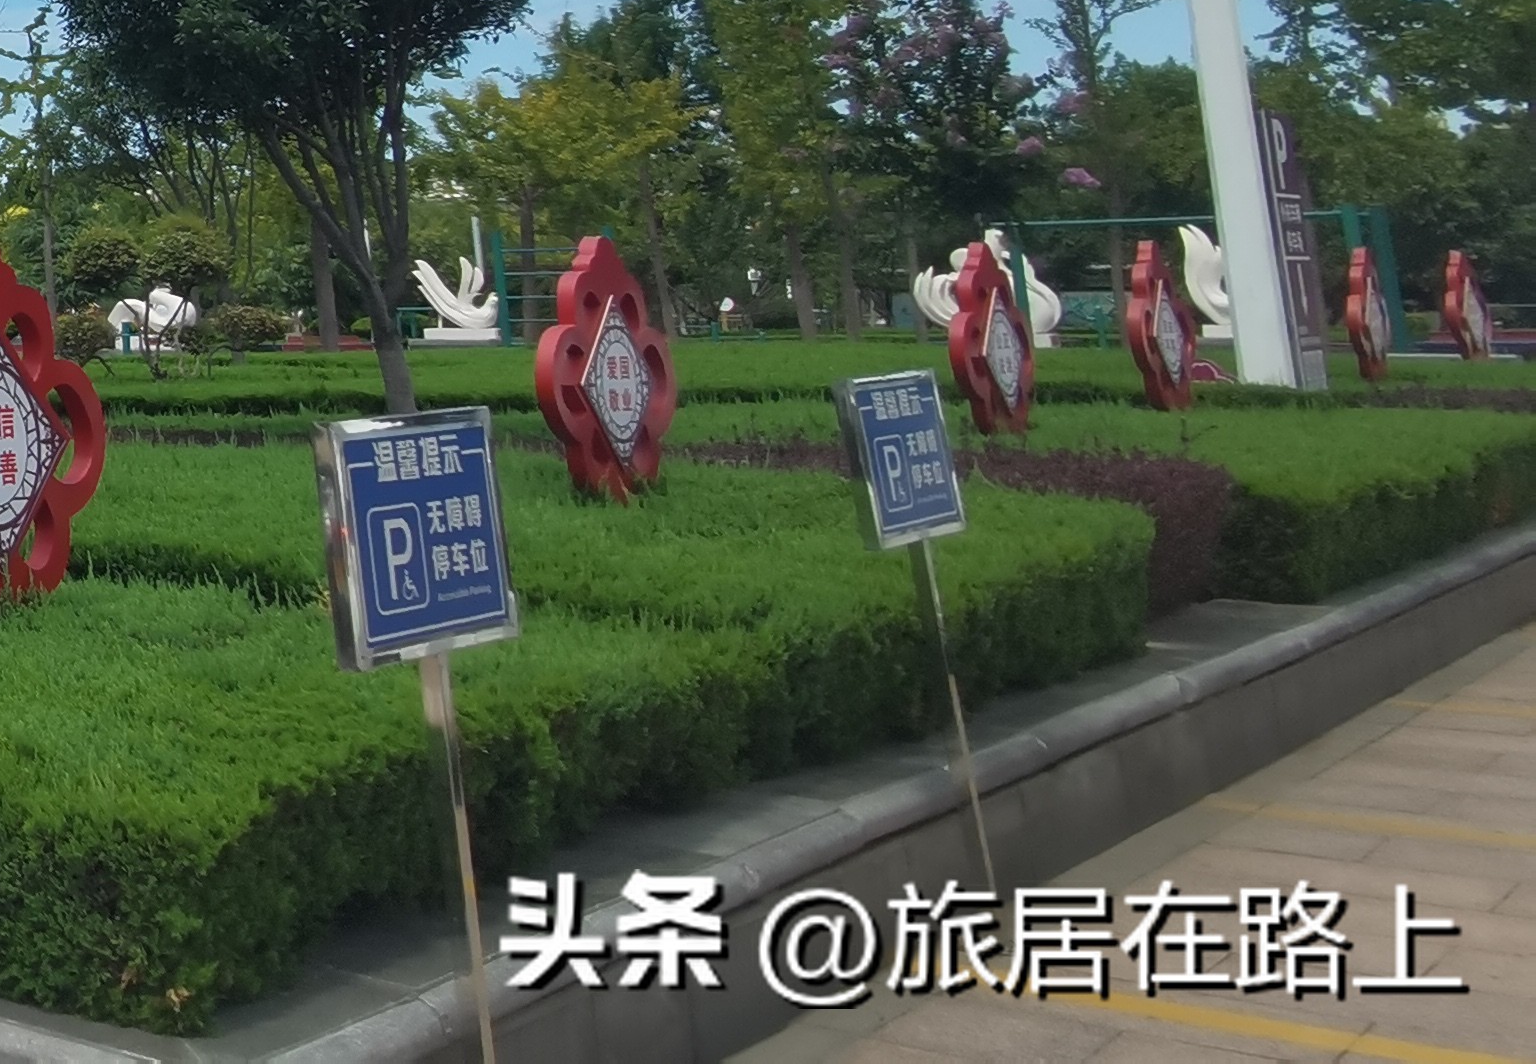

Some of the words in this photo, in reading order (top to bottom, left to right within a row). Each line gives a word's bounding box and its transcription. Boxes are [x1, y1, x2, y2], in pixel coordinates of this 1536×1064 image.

[372, 434, 464, 483] 温馨提示
[882, 445, 902, 502] P
[426, 494, 483, 535] 无障碍
[383, 517, 414, 601] P
[431, 538, 489, 581] 停车位
